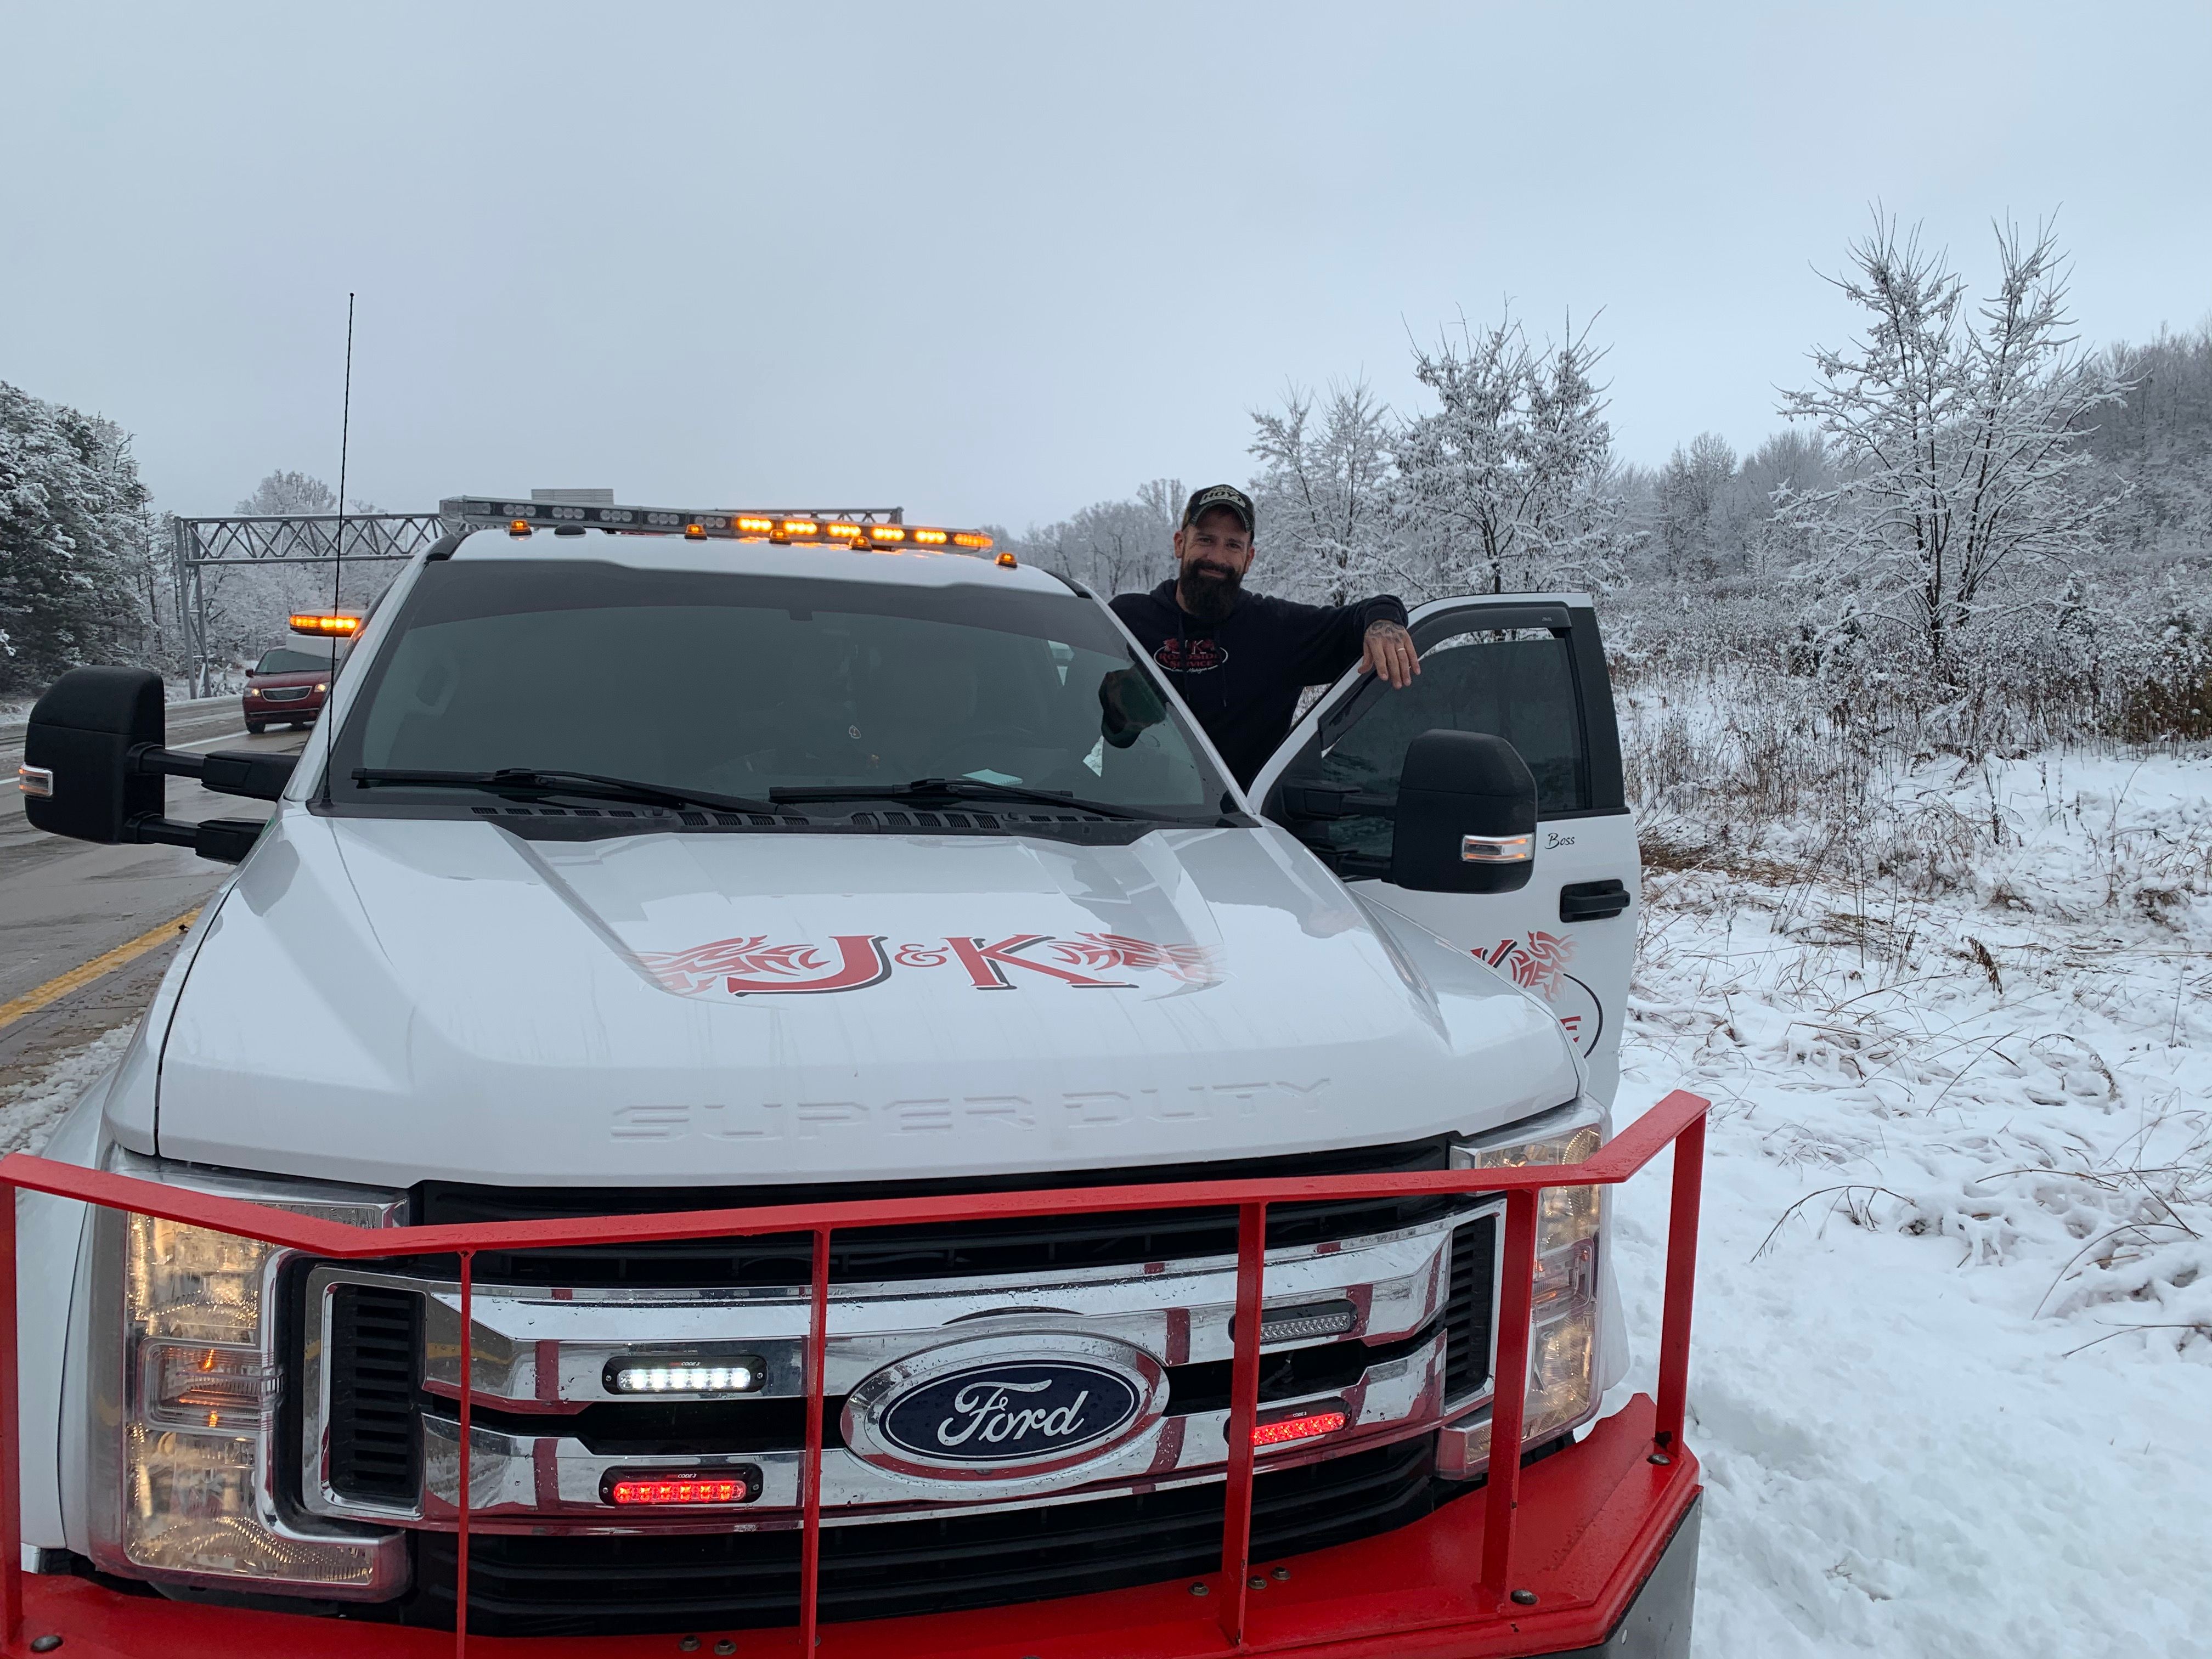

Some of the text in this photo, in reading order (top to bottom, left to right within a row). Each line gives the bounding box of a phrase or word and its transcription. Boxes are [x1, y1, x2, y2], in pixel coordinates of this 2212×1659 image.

[1544, 832, 1575, 849] Boss
[610, 1077, 1330, 1142] SUPER DUTY
[937, 1379, 1089, 1447] Ford
